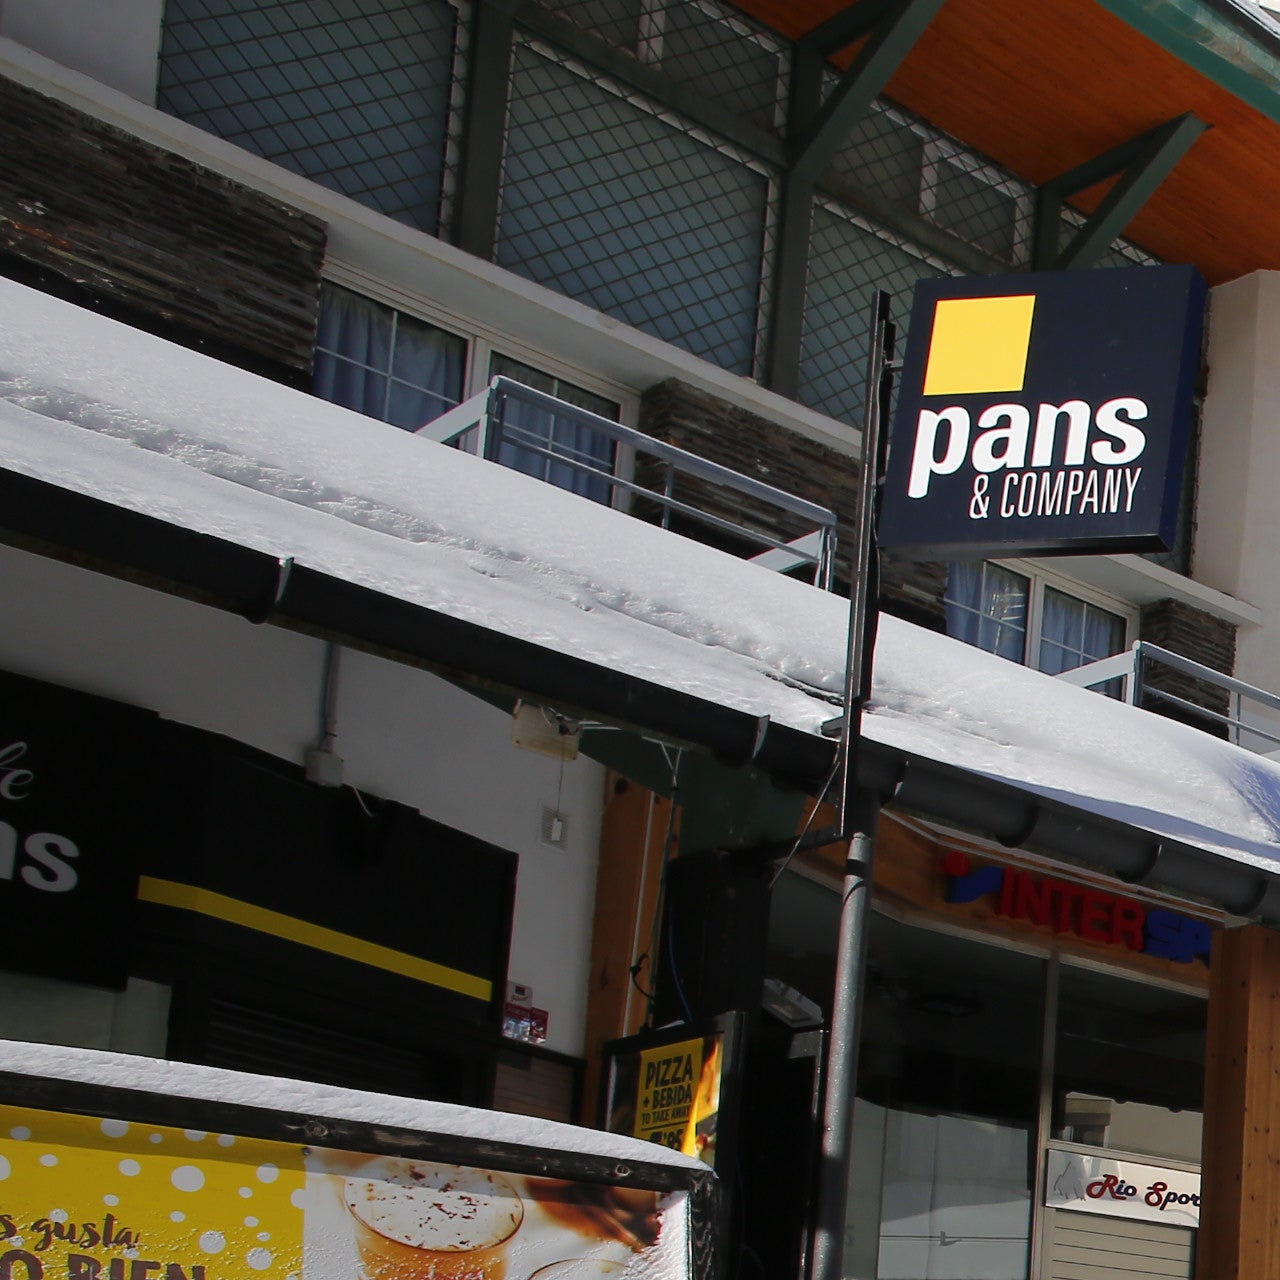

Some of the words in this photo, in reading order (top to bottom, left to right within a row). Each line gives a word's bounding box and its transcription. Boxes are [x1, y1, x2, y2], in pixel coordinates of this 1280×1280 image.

[907, 397, 1149, 499] pans
[968, 474, 990, 519] &
[999, 467, 1142, 518] COMPANY
[646, 1053, 694, 1090] PIZZA
[652, 1084, 693, 1110] BEBIDA
[642, 1113, 651, 1125] TO
[653, 1108, 670, 1123] TAKE
[1086, 1174, 1138, 1201] Rio
